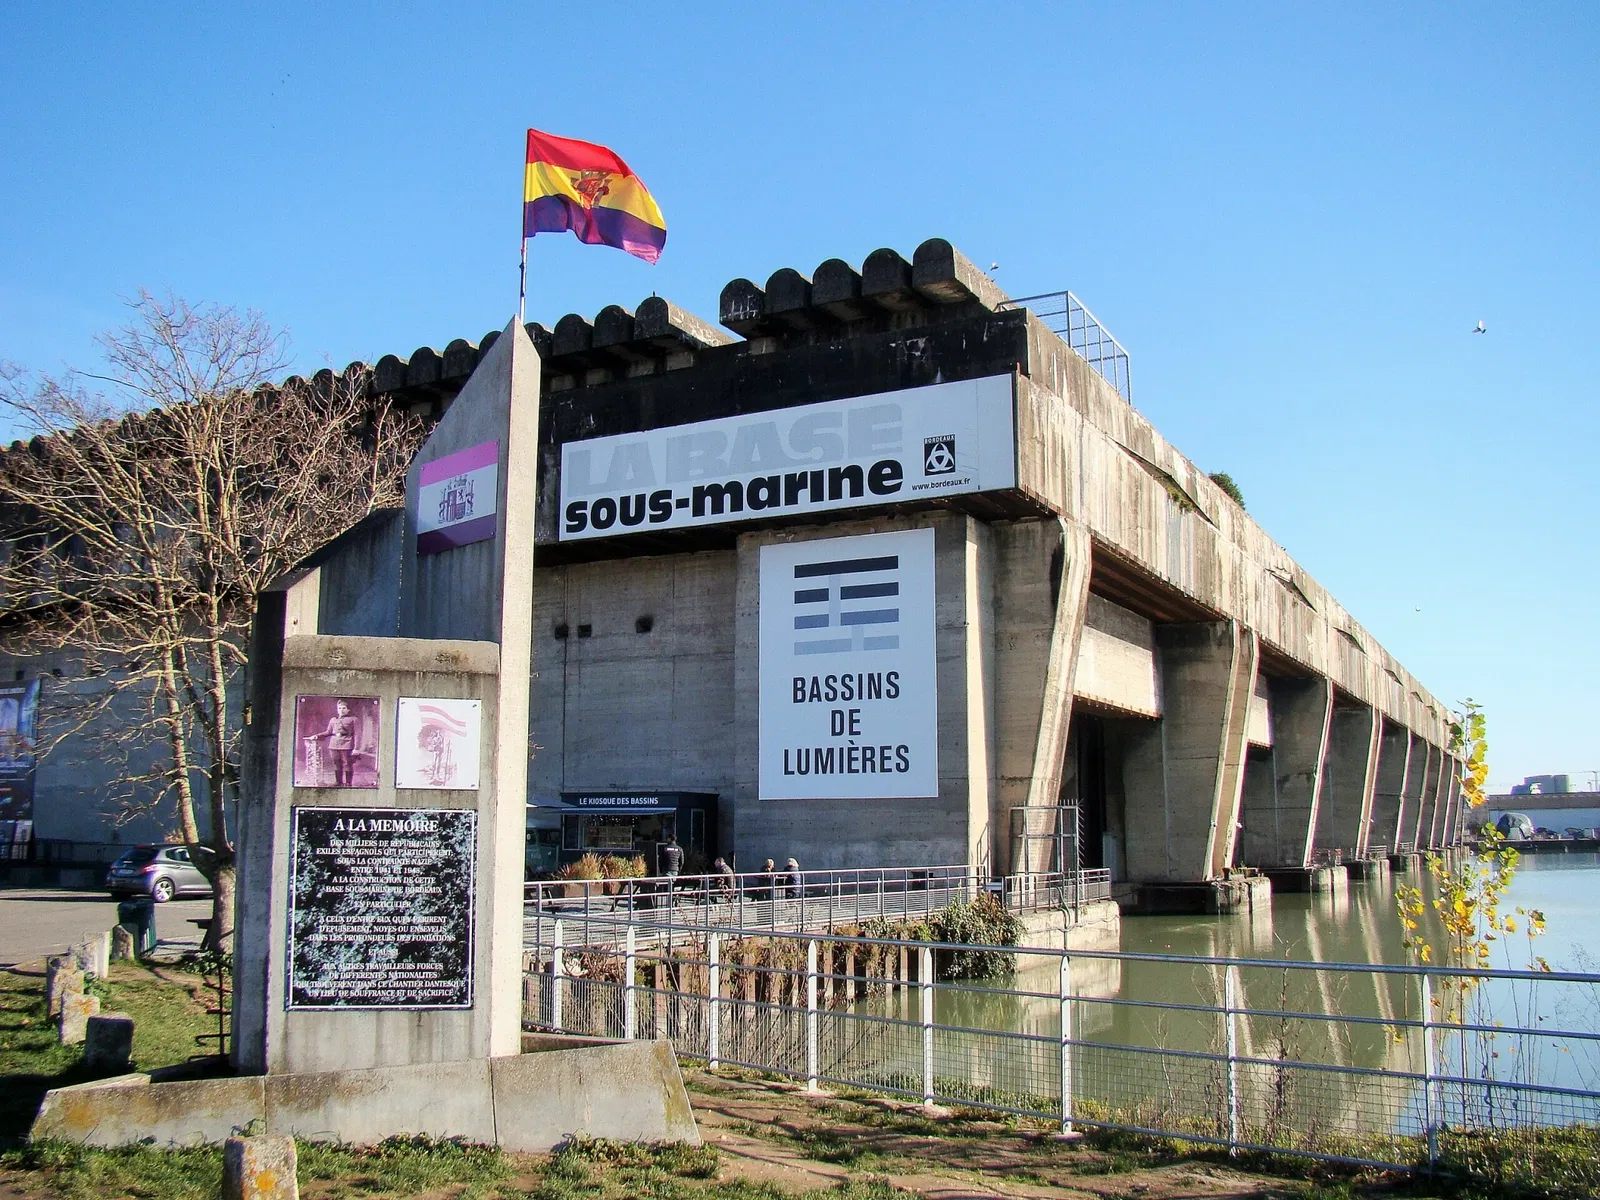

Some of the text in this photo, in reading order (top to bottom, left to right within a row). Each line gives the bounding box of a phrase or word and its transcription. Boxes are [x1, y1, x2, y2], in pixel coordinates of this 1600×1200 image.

[568, 402, 903, 498] LA BASE
[924, 435, 955, 444] BORDEAUX
[566, 459, 904, 533] sous-marine
[912, 478, 971, 491] www.bordeaux.fr
[793, 671, 900, 704] BASSINS
[831, 709, 861, 736] DE
[784, 740, 910, 775] LUMIÈRES
[588, 797, 616, 805] KIOSQUE
[616, 797, 630, 805] DES
[630, 797, 659, 805] BASSINS
[333, 819, 439, 833] A LA MEMOIRE
